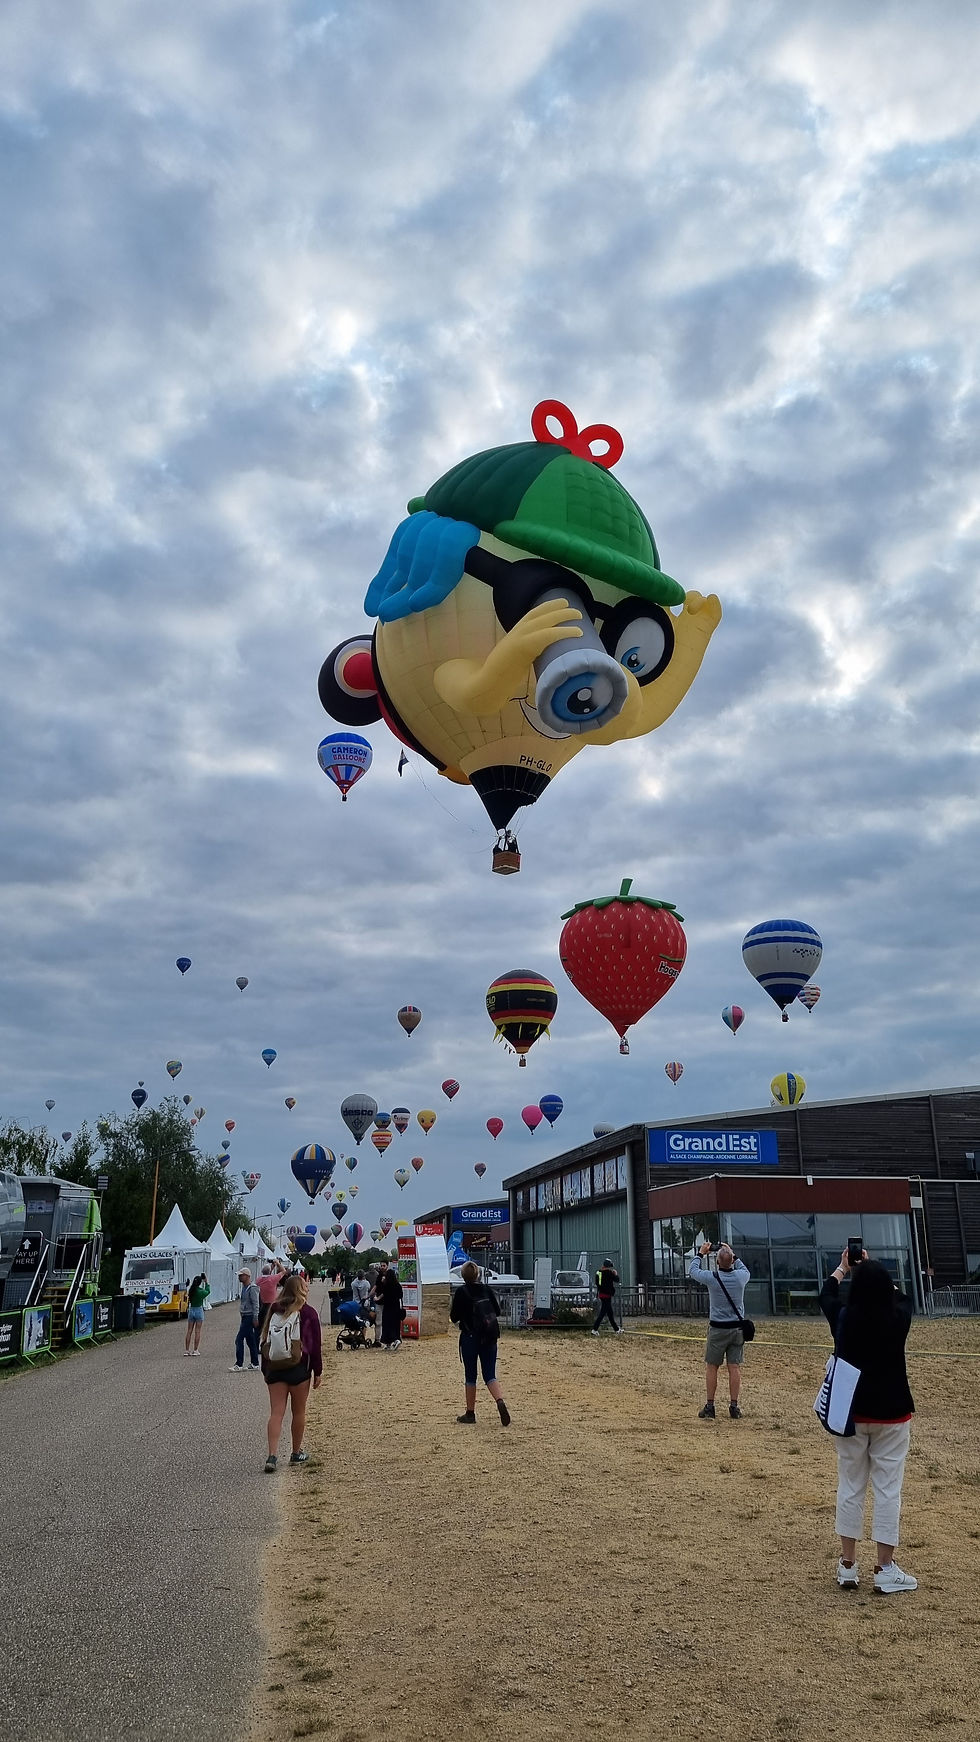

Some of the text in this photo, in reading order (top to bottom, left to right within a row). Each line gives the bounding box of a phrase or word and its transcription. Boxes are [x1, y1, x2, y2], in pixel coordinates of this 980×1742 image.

[331, 746, 368, 757] CAMERON
[333, 754, 366, 763] BALLOONS
[343, 1108, 373, 1116] desco
